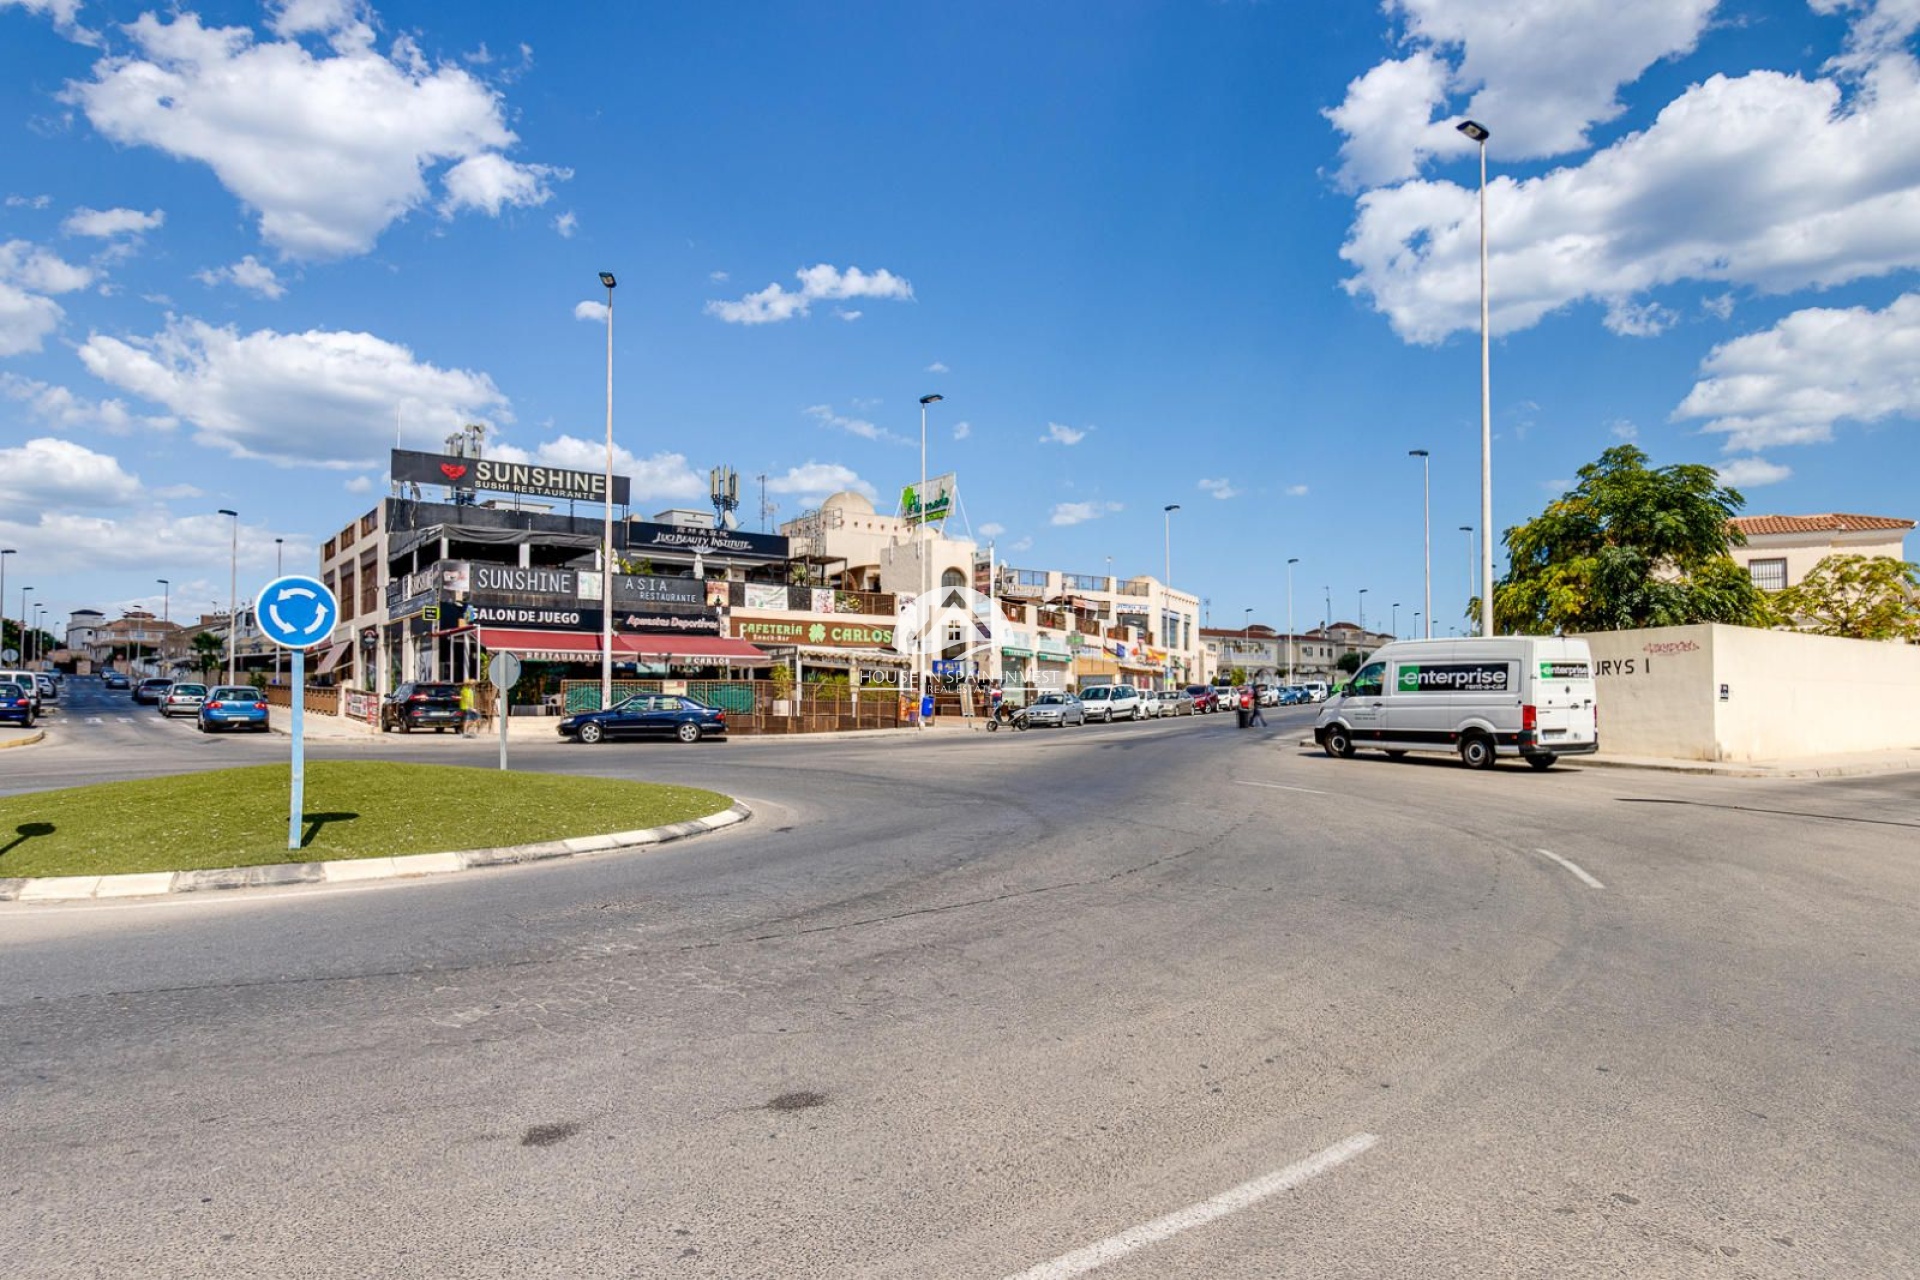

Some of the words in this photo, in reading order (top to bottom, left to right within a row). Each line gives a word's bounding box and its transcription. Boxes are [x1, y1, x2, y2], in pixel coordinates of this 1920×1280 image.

[476, 461, 606, 494] SUNSHINE
[475, 480, 510, 491] SUSHI
[514, 484, 596, 500] RESTAURANTE
[676, 534, 709, 546] BEAUTY
[710, 537, 753, 549] INSTITUTE
[478, 568, 572, 594] SUNSHINE
[625, 577, 668, 592] ASIA
[640, 591, 697, 603] RESTAURANTE
[520, 609, 536, 623] DE
[537, 610, 580, 625] JUEGO
[831, 626, 893, 644] CARLOS
[693, 656, 730, 665] CARLOS
[1542, 664, 1589, 676] enterprise
[1403, 668, 1507, 689] enterprise
